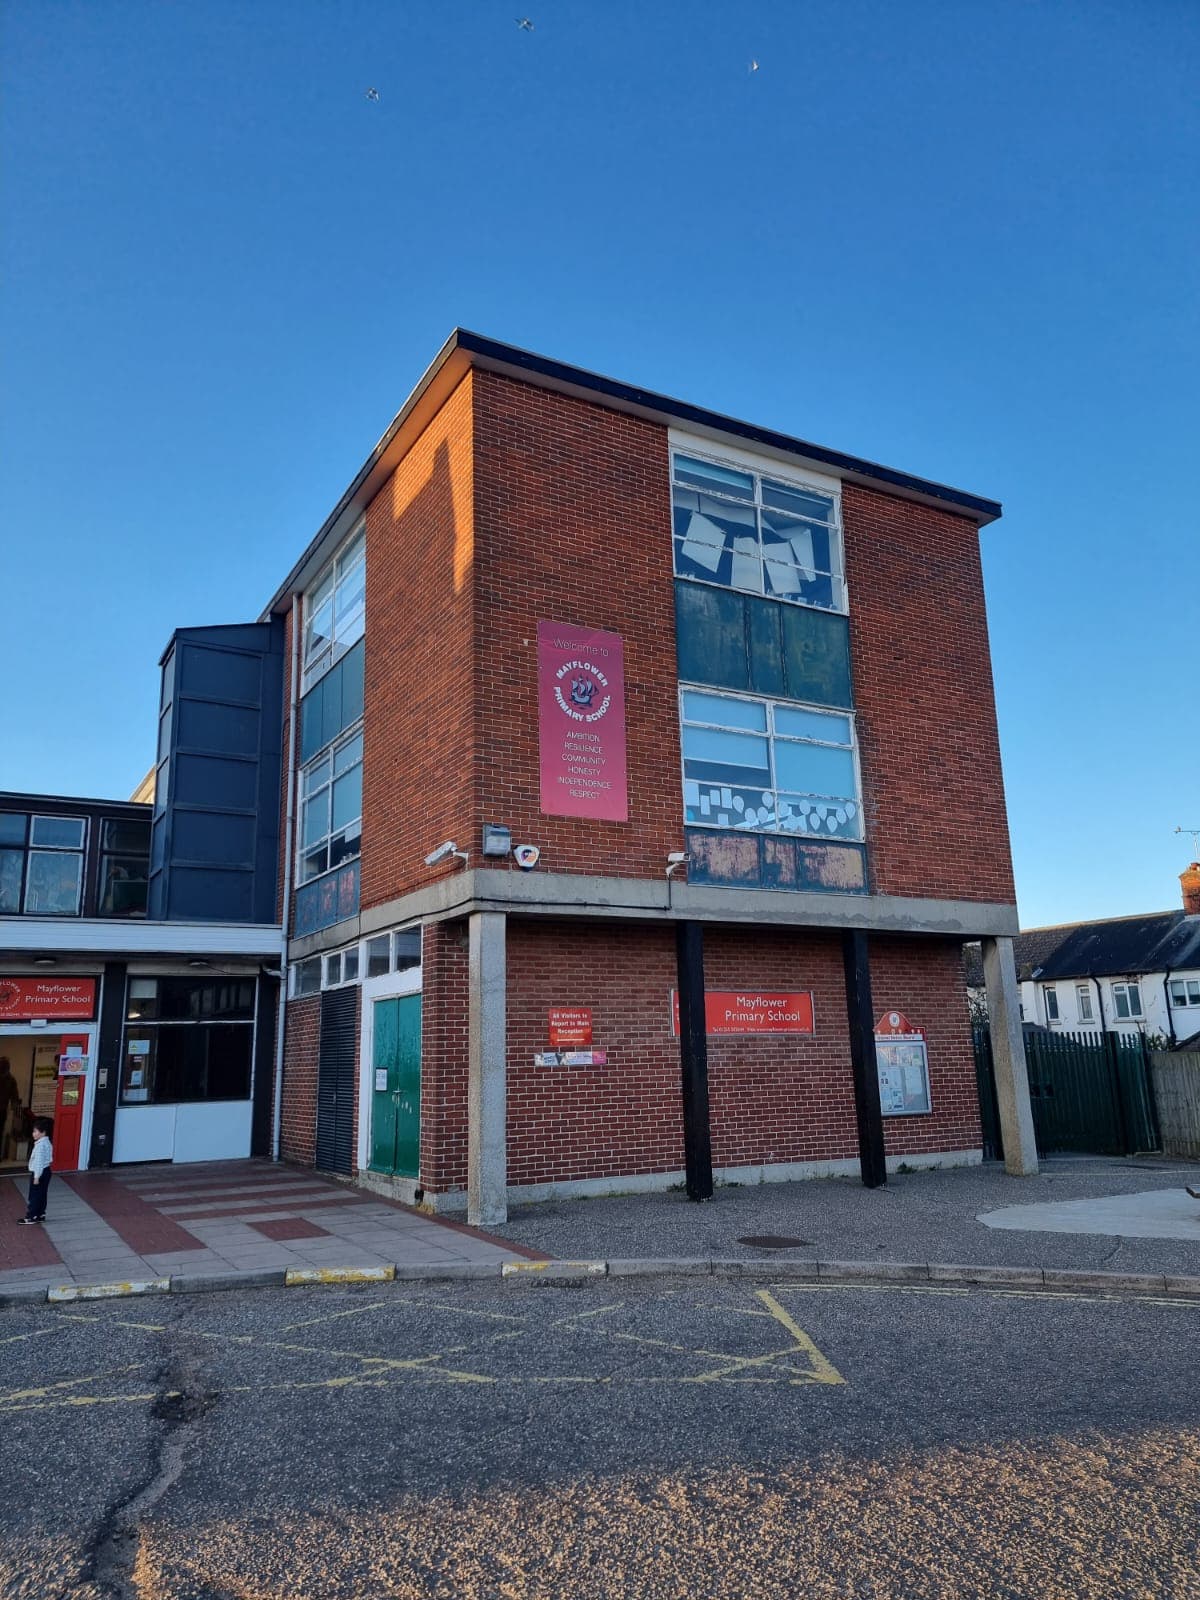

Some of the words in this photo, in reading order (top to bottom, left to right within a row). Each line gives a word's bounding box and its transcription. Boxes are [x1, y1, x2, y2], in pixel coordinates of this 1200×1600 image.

[554, 637, 599, 655] Welcome
[600, 647, 609, 657] to
[556, 660, 609, 687] MAYFLOWER
[553, 686, 584, 722] PRIMARY
[586, 695, 611, 722] SCHOOL
[566, 731, 600, 743] AMBITION
[564, 741, 604, 755] RESILIENCE
[561, 753, 606, 766] COMMUNITY
[567, 765, 601, 776] HONESTY
[557, 776, 613, 790] INDEPENDENCE
[569, 789, 600, 799] RESPECT
[36, 984, 82, 995] Mayflower
[25, 995, 60, 1005] Primary
[62, 995, 91, 1003] School
[736, 996, 788, 1010] Mayflower
[725, 1010, 765, 1024] Primary
[767, 1010, 801, 1022] School
